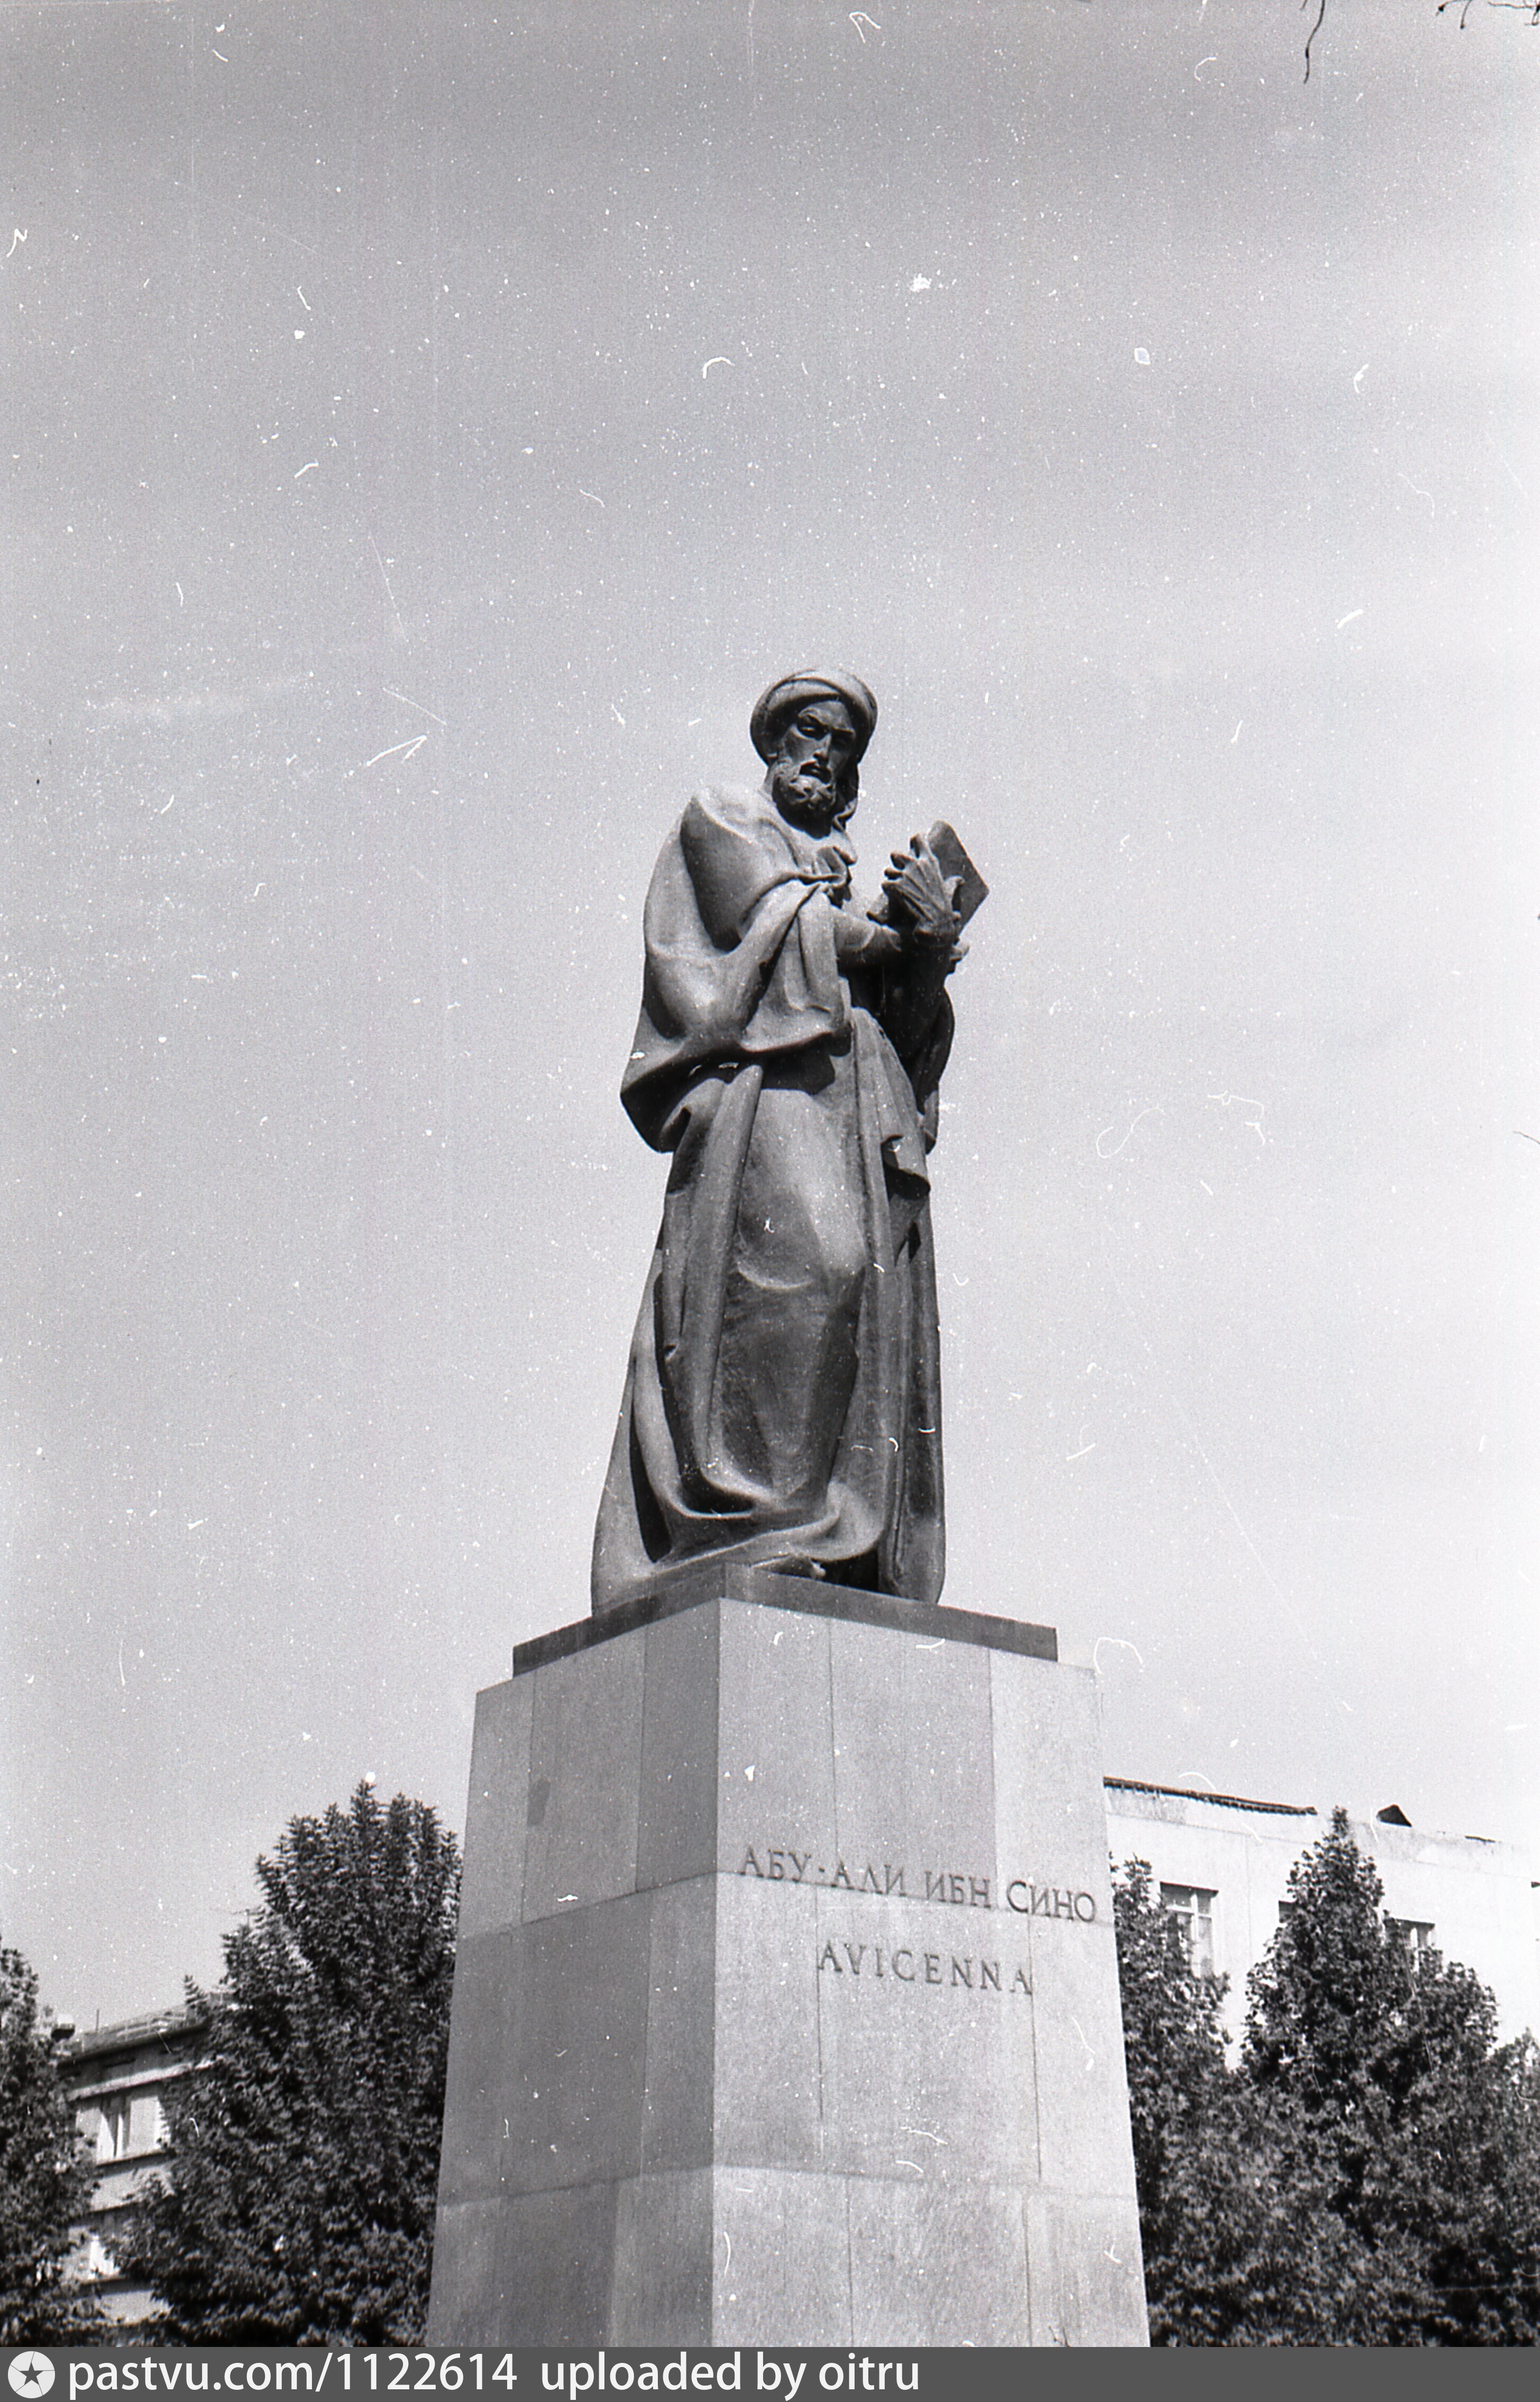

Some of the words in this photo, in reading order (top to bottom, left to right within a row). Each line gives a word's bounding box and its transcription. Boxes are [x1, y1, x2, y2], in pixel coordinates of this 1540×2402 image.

[924, 1871, 992, 1908] ИБН
[1006, 1880, 1096, 1922] СИНО
[817, 1939, 1034, 1995] AVICENNA
